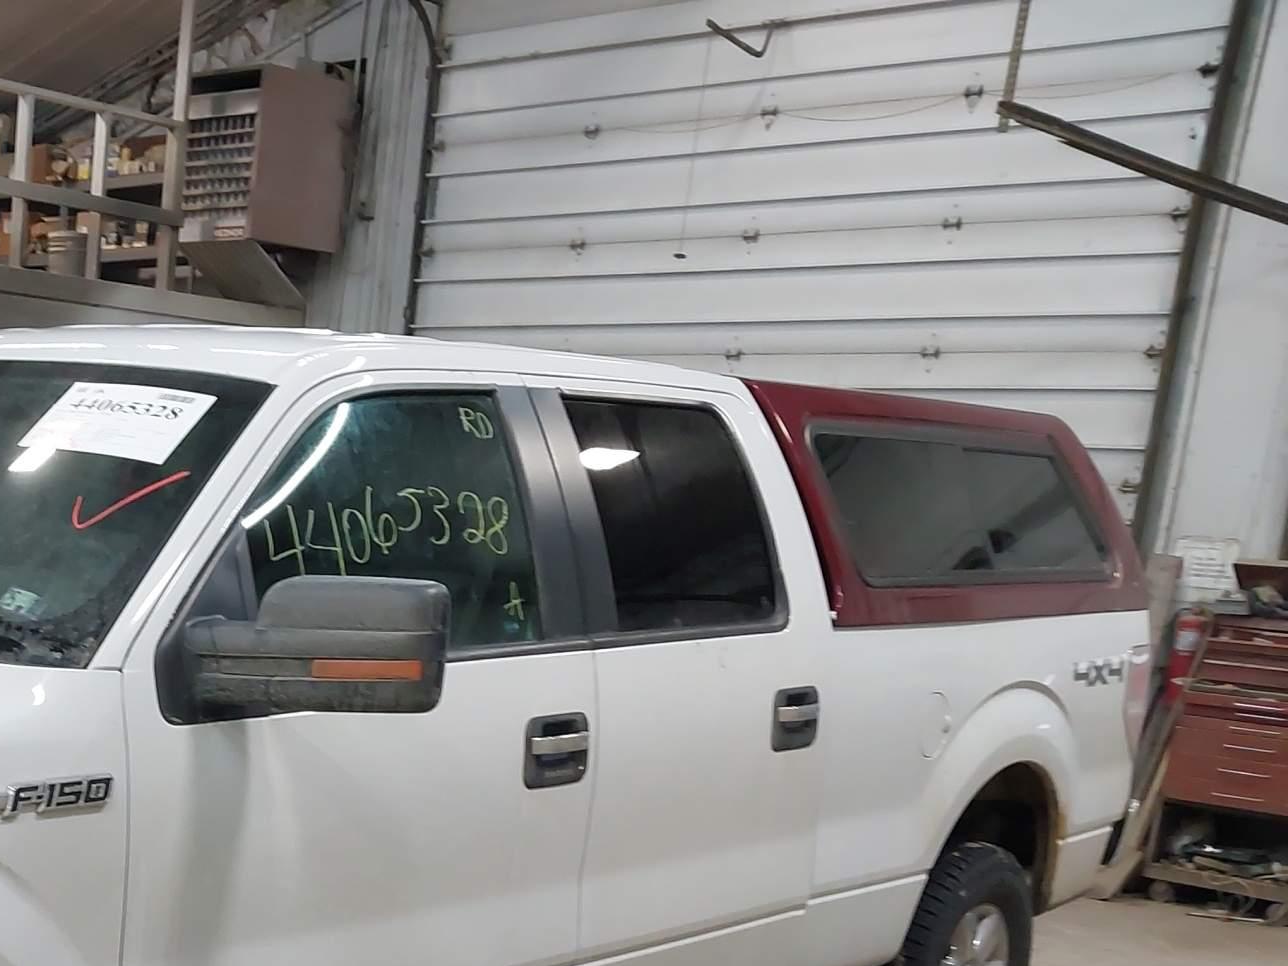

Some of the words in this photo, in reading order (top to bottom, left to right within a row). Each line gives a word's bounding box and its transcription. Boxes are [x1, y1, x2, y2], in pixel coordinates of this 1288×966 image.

[69, 398, 184, 420] 44065328
[263, 485, 509, 576] 44065328
[10, 776, 113, 812] F-150
